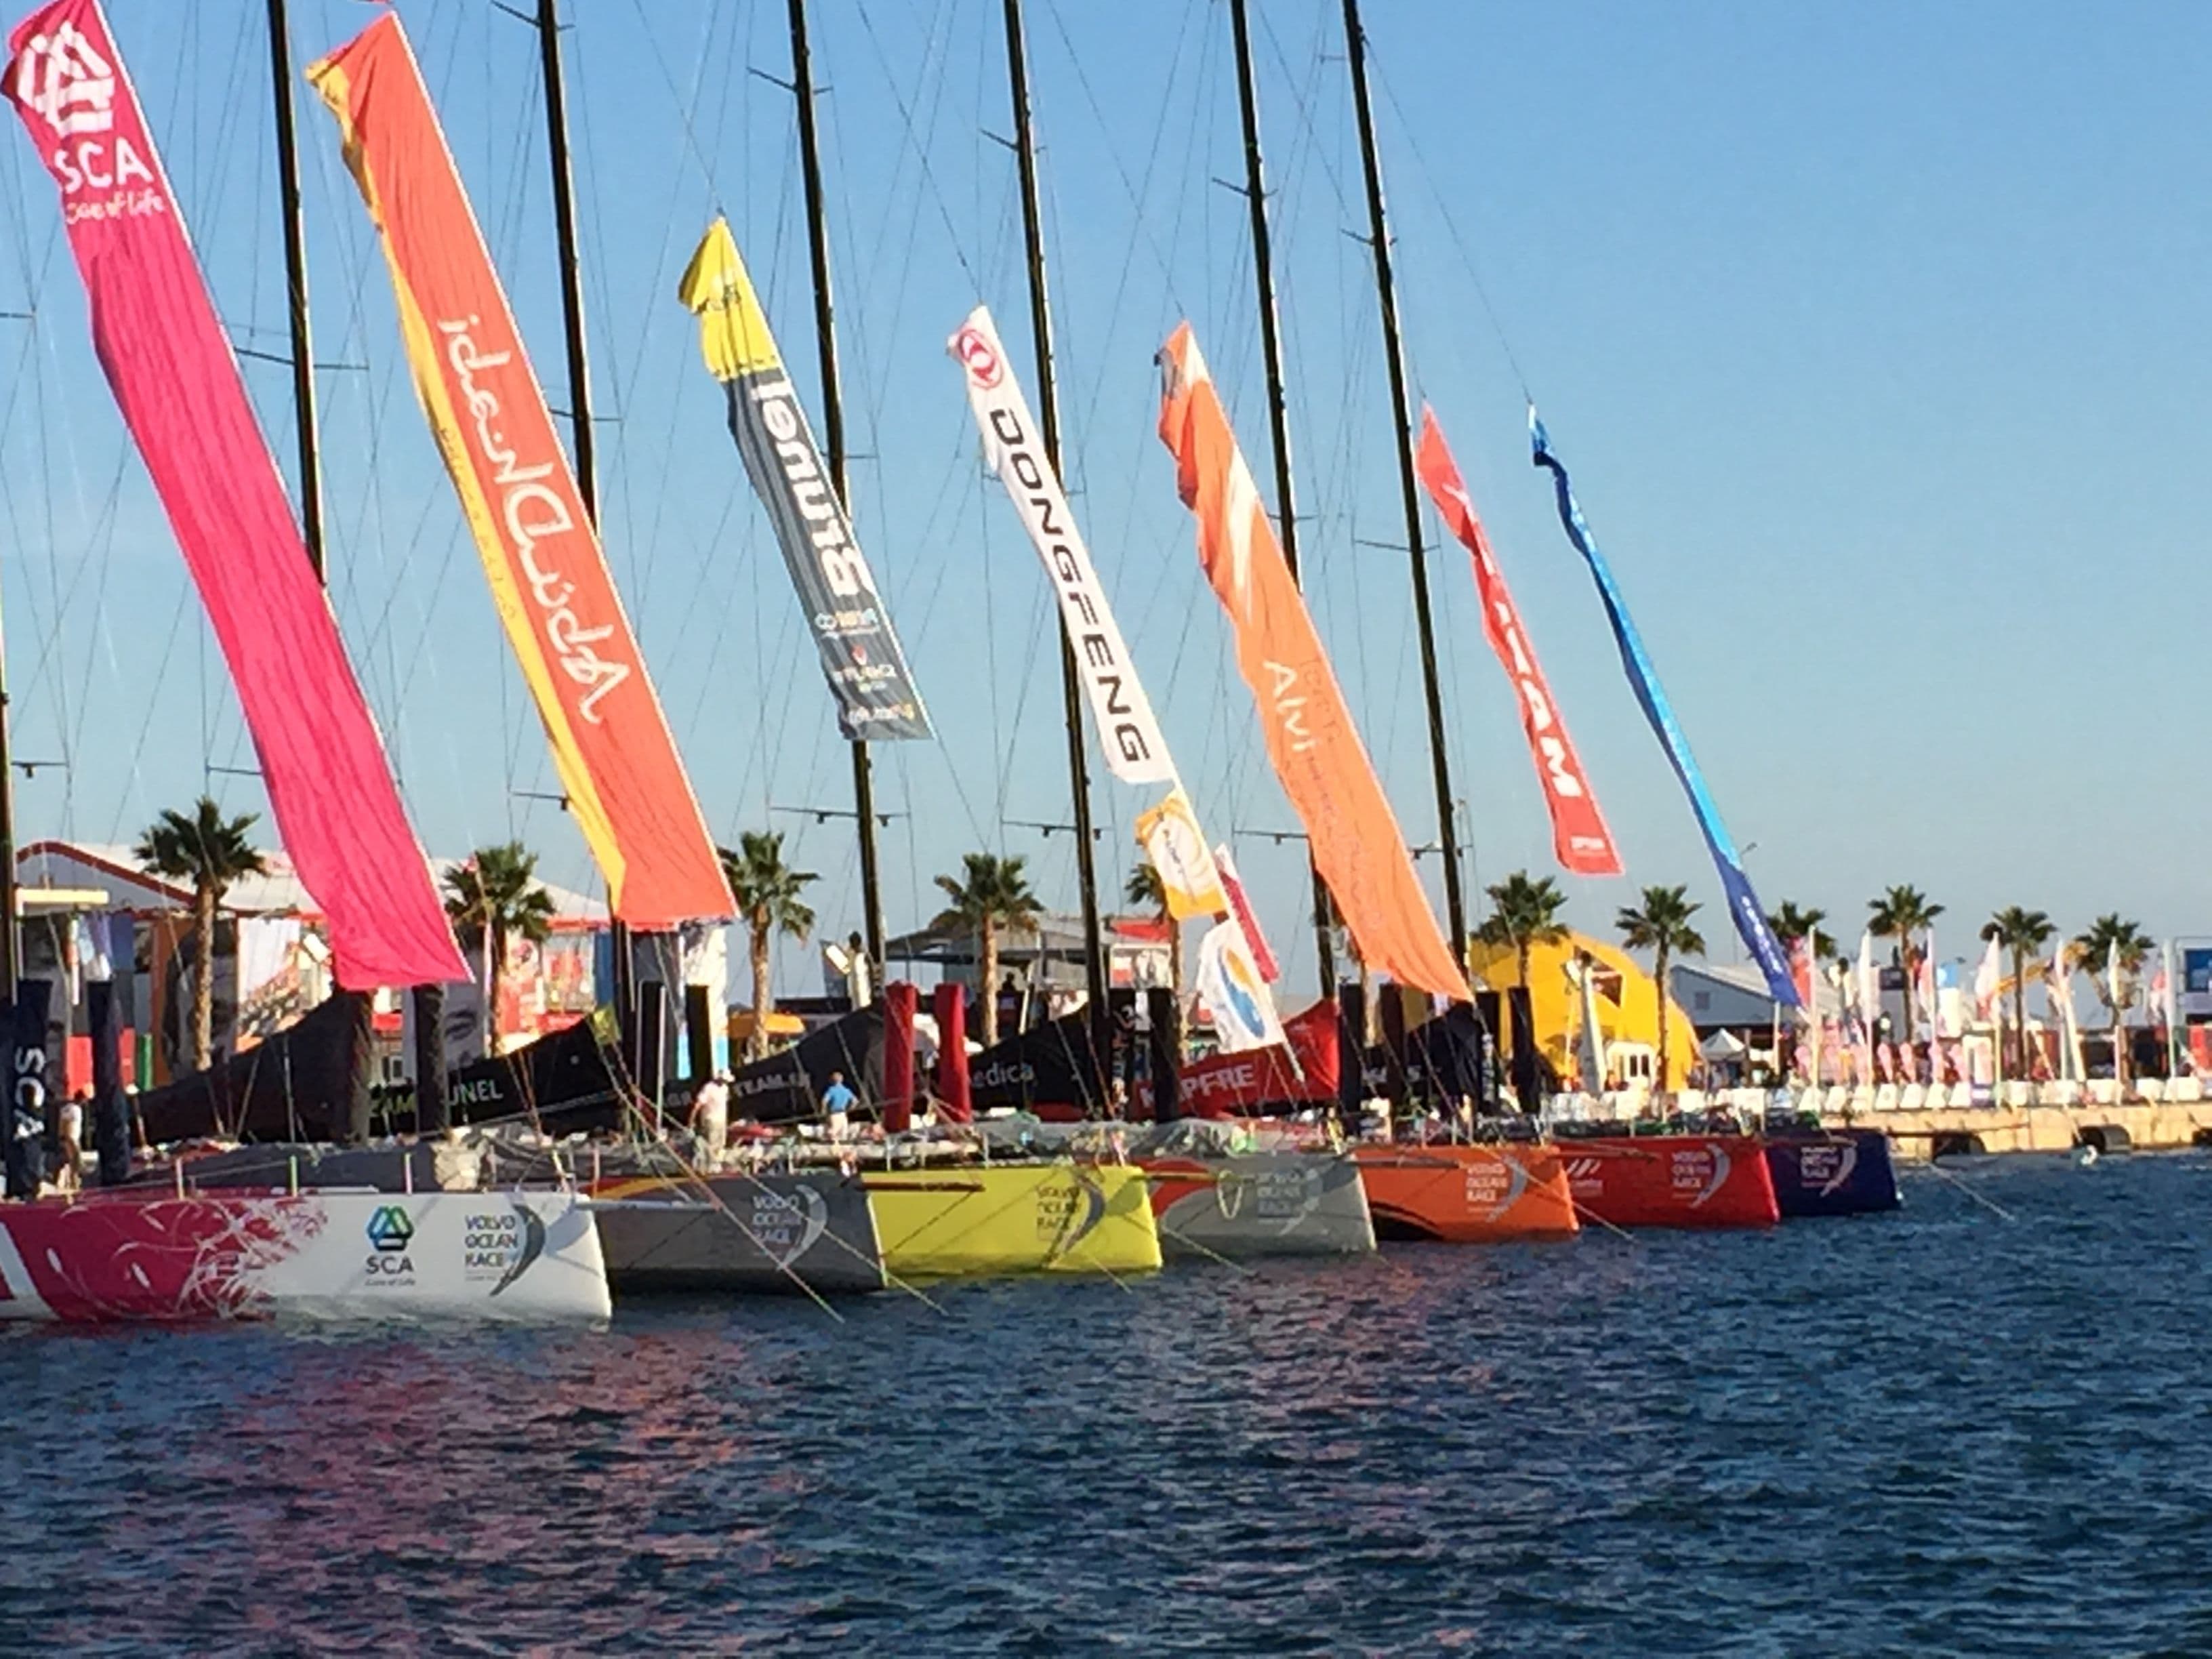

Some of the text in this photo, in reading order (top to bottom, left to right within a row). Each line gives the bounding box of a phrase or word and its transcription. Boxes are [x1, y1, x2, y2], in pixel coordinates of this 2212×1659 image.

[54, 136, 154, 194] SCA
[989, 408, 1151, 762] DONGFENG
[14, 1046, 45, 1141] SCA
[465, 1215, 515, 1230] VOLVO
[464, 1234, 518, 1248] OCEAN
[365, 1255, 414, 1274] SCA
[465, 1252, 504, 1267] RACE
